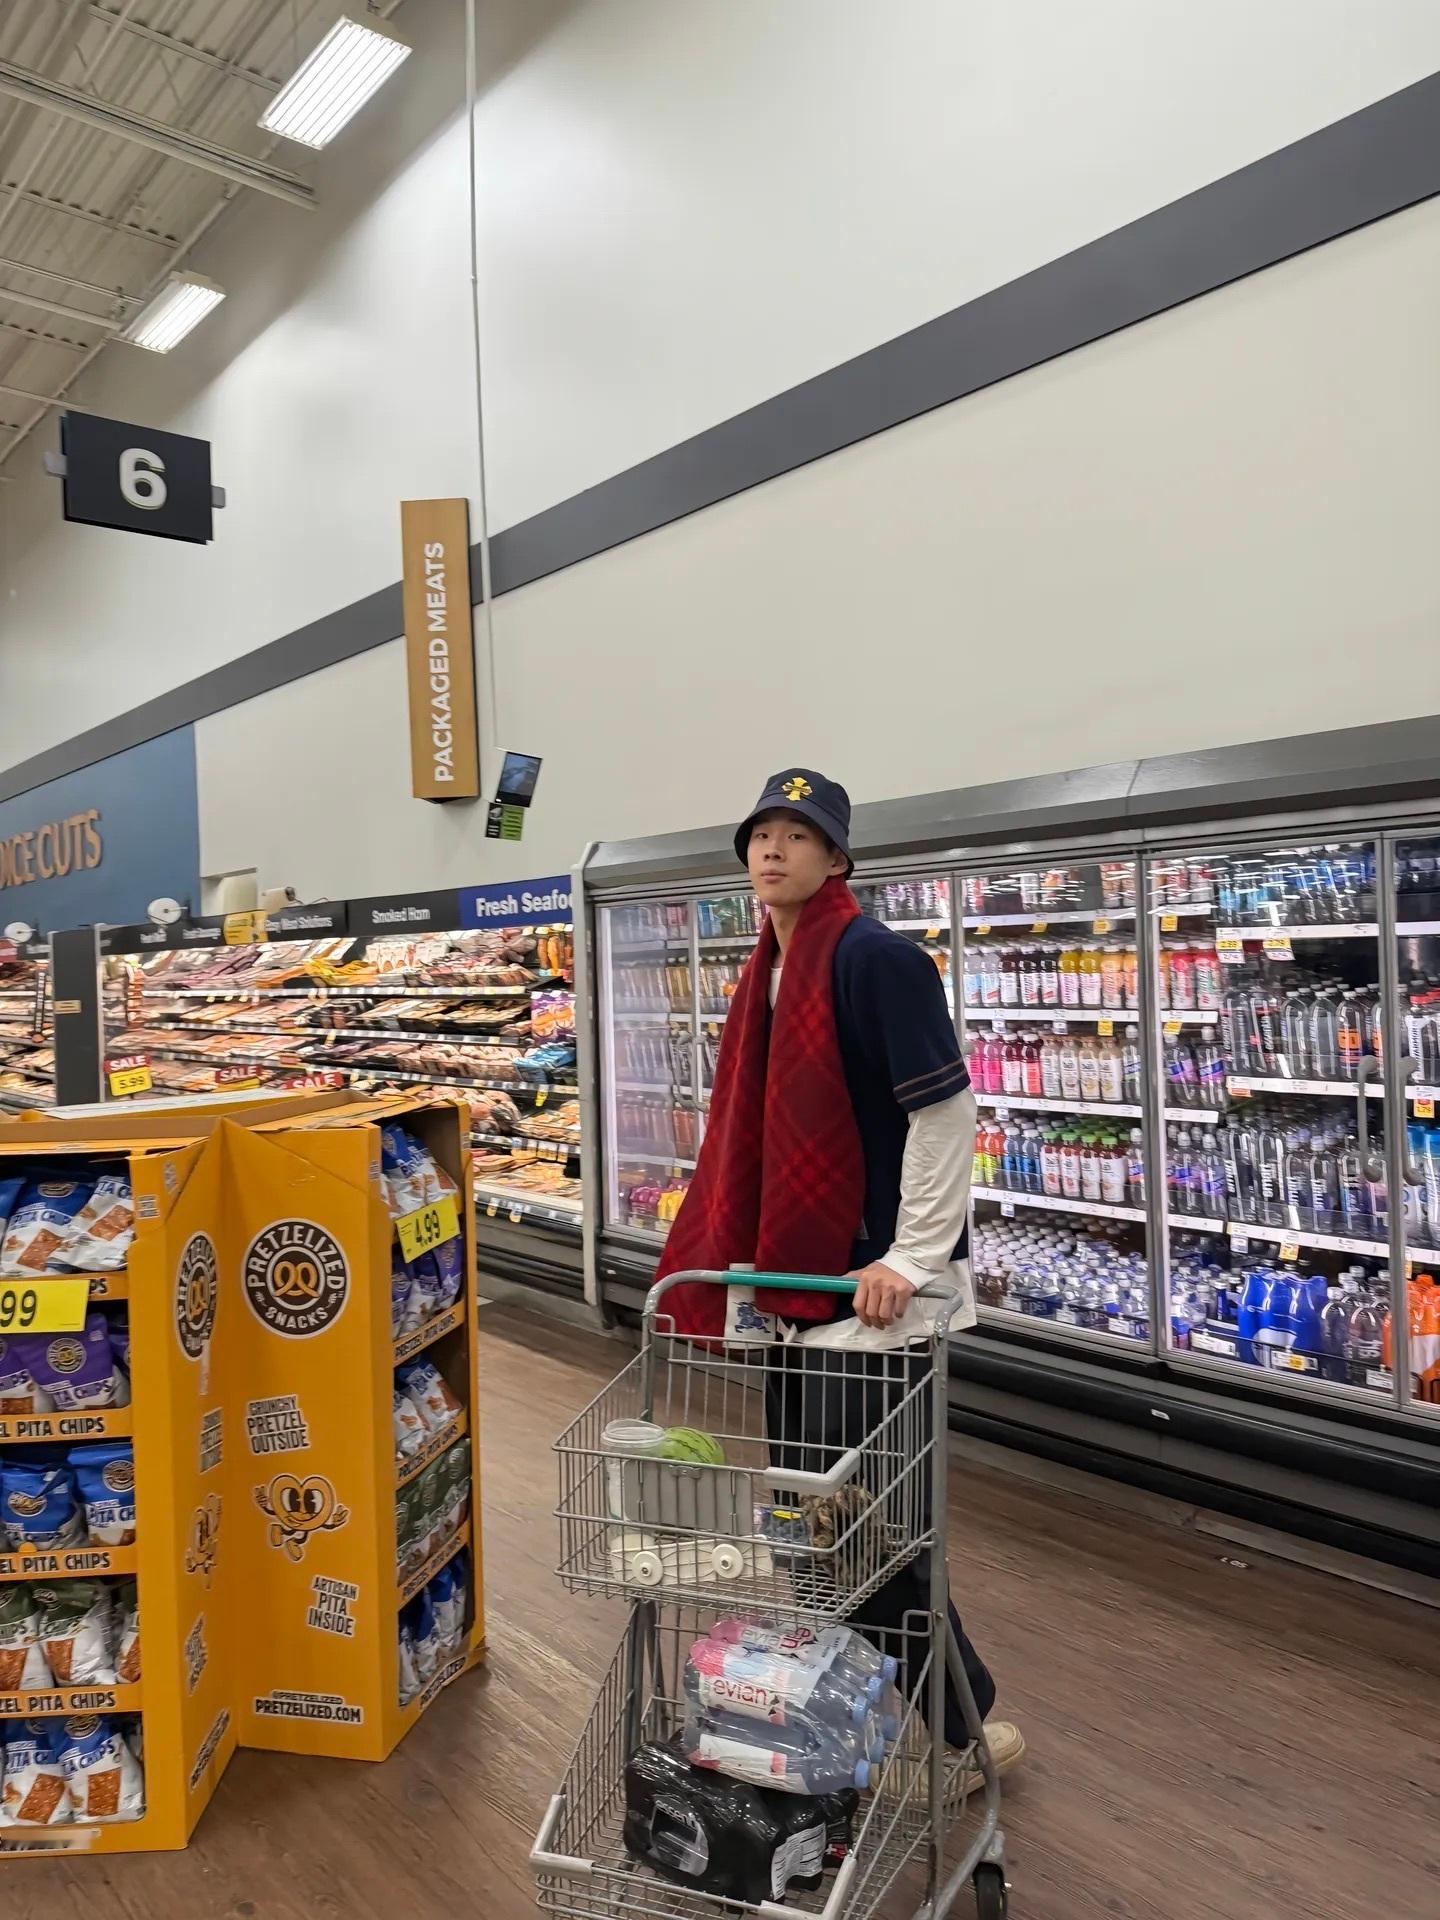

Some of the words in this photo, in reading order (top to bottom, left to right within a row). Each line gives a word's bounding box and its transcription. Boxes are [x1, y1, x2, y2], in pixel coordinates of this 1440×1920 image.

[119, 448, 167, 510] 6
[424, 542, 448, 632] MEATS
[428, 637, 454, 783] PACKAGED
[37, 809, 102, 879] CUTS
[476, 895, 518, 918] Fresh
[110, 1055, 145, 1071] SALE
[221, 1065, 258, 1082] SALE
[292, 1074, 335, 1088] SALE
[247, 1225, 345, 1289] PRETZELIZED
[265, 1306, 328, 1329] SNACKS
[17, 1420, 53, 1437] PITA
[59, 1416, 105, 1435] CHIPS
[247, 1411, 306, 1435] PRETZEL
[251, 1429, 309, 1453] OUTSIDE
[22, 1556, 59, 1573] PITA
[65, 1552, 110, 1570] CHIPS
[313, 1577, 357, 1600] ARTISAN
[318, 1592, 347, 1615] PITA
[308, 1607, 354, 1635] INSIDE
[28, 1694, 65, 1711] PITA
[70, 1691, 116, 1709] CHIPS
[713, 1679, 767, 1706] evian
[255, 1698, 361, 1723] PRETZELIZED.COM
